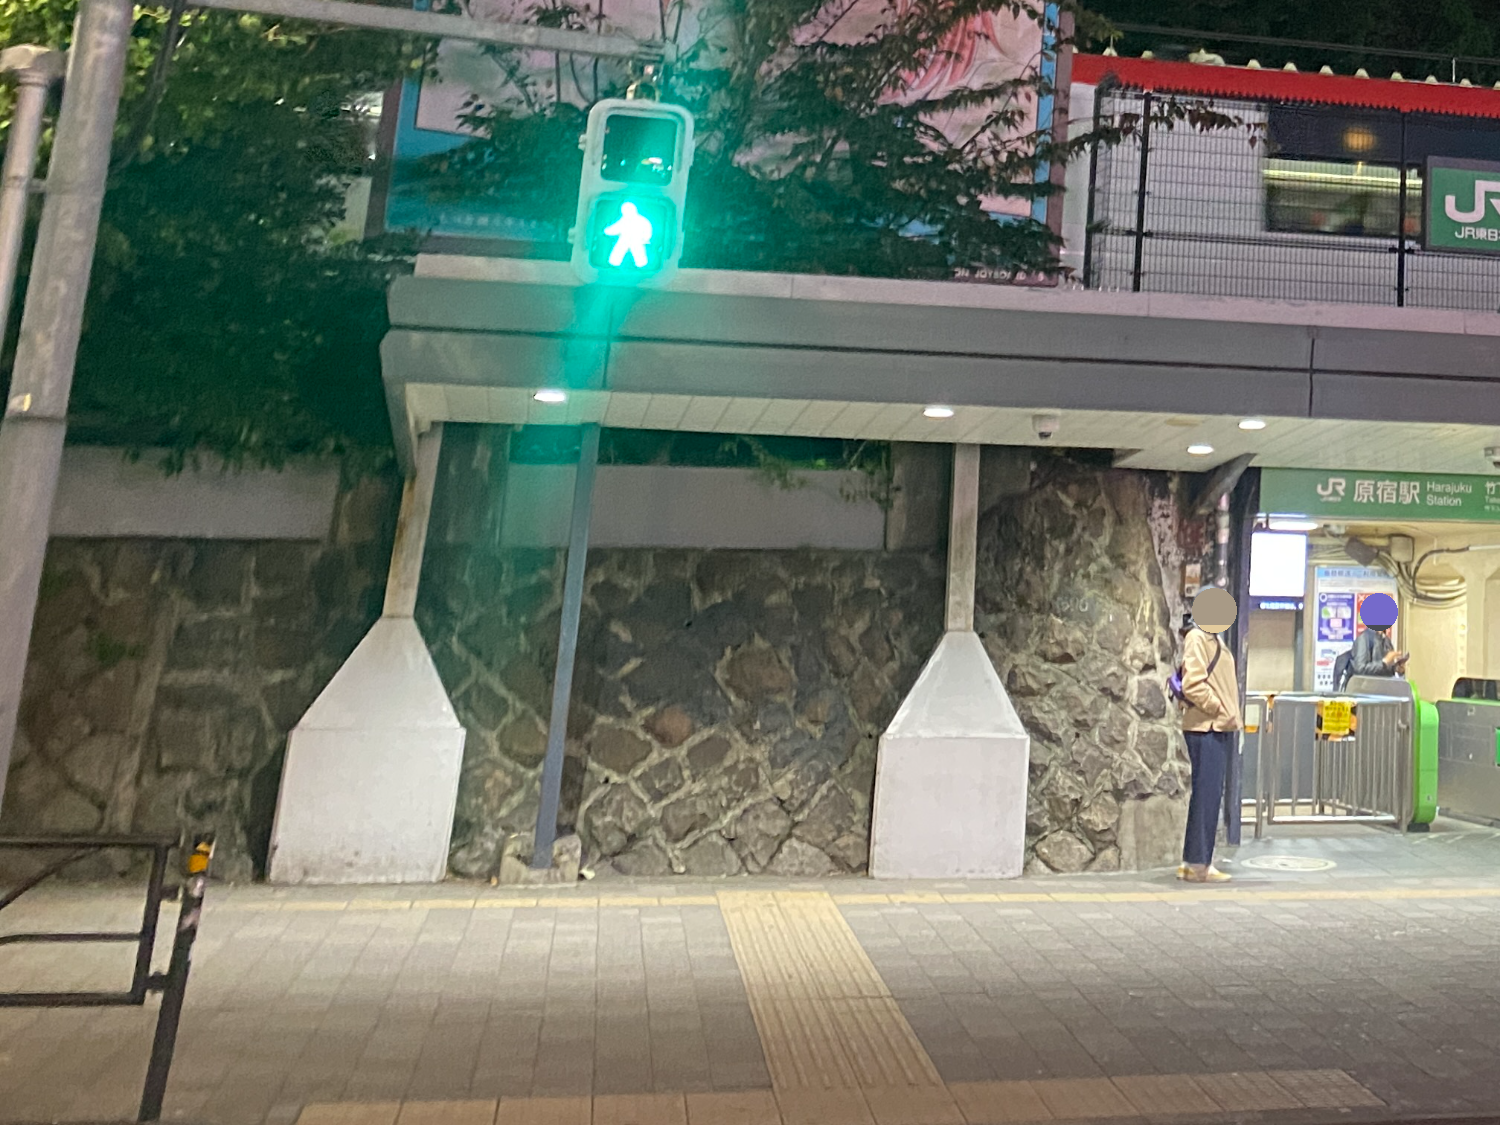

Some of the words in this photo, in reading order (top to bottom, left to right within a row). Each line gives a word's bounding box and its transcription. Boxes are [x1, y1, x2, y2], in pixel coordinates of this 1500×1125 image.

[1316, 477, 1347, 497] JR
[1353, 479, 1420, 505] 原宿駅
[1426, 481, 1473, 495] Harajuku
[1426, 494, 1462, 507] Station
